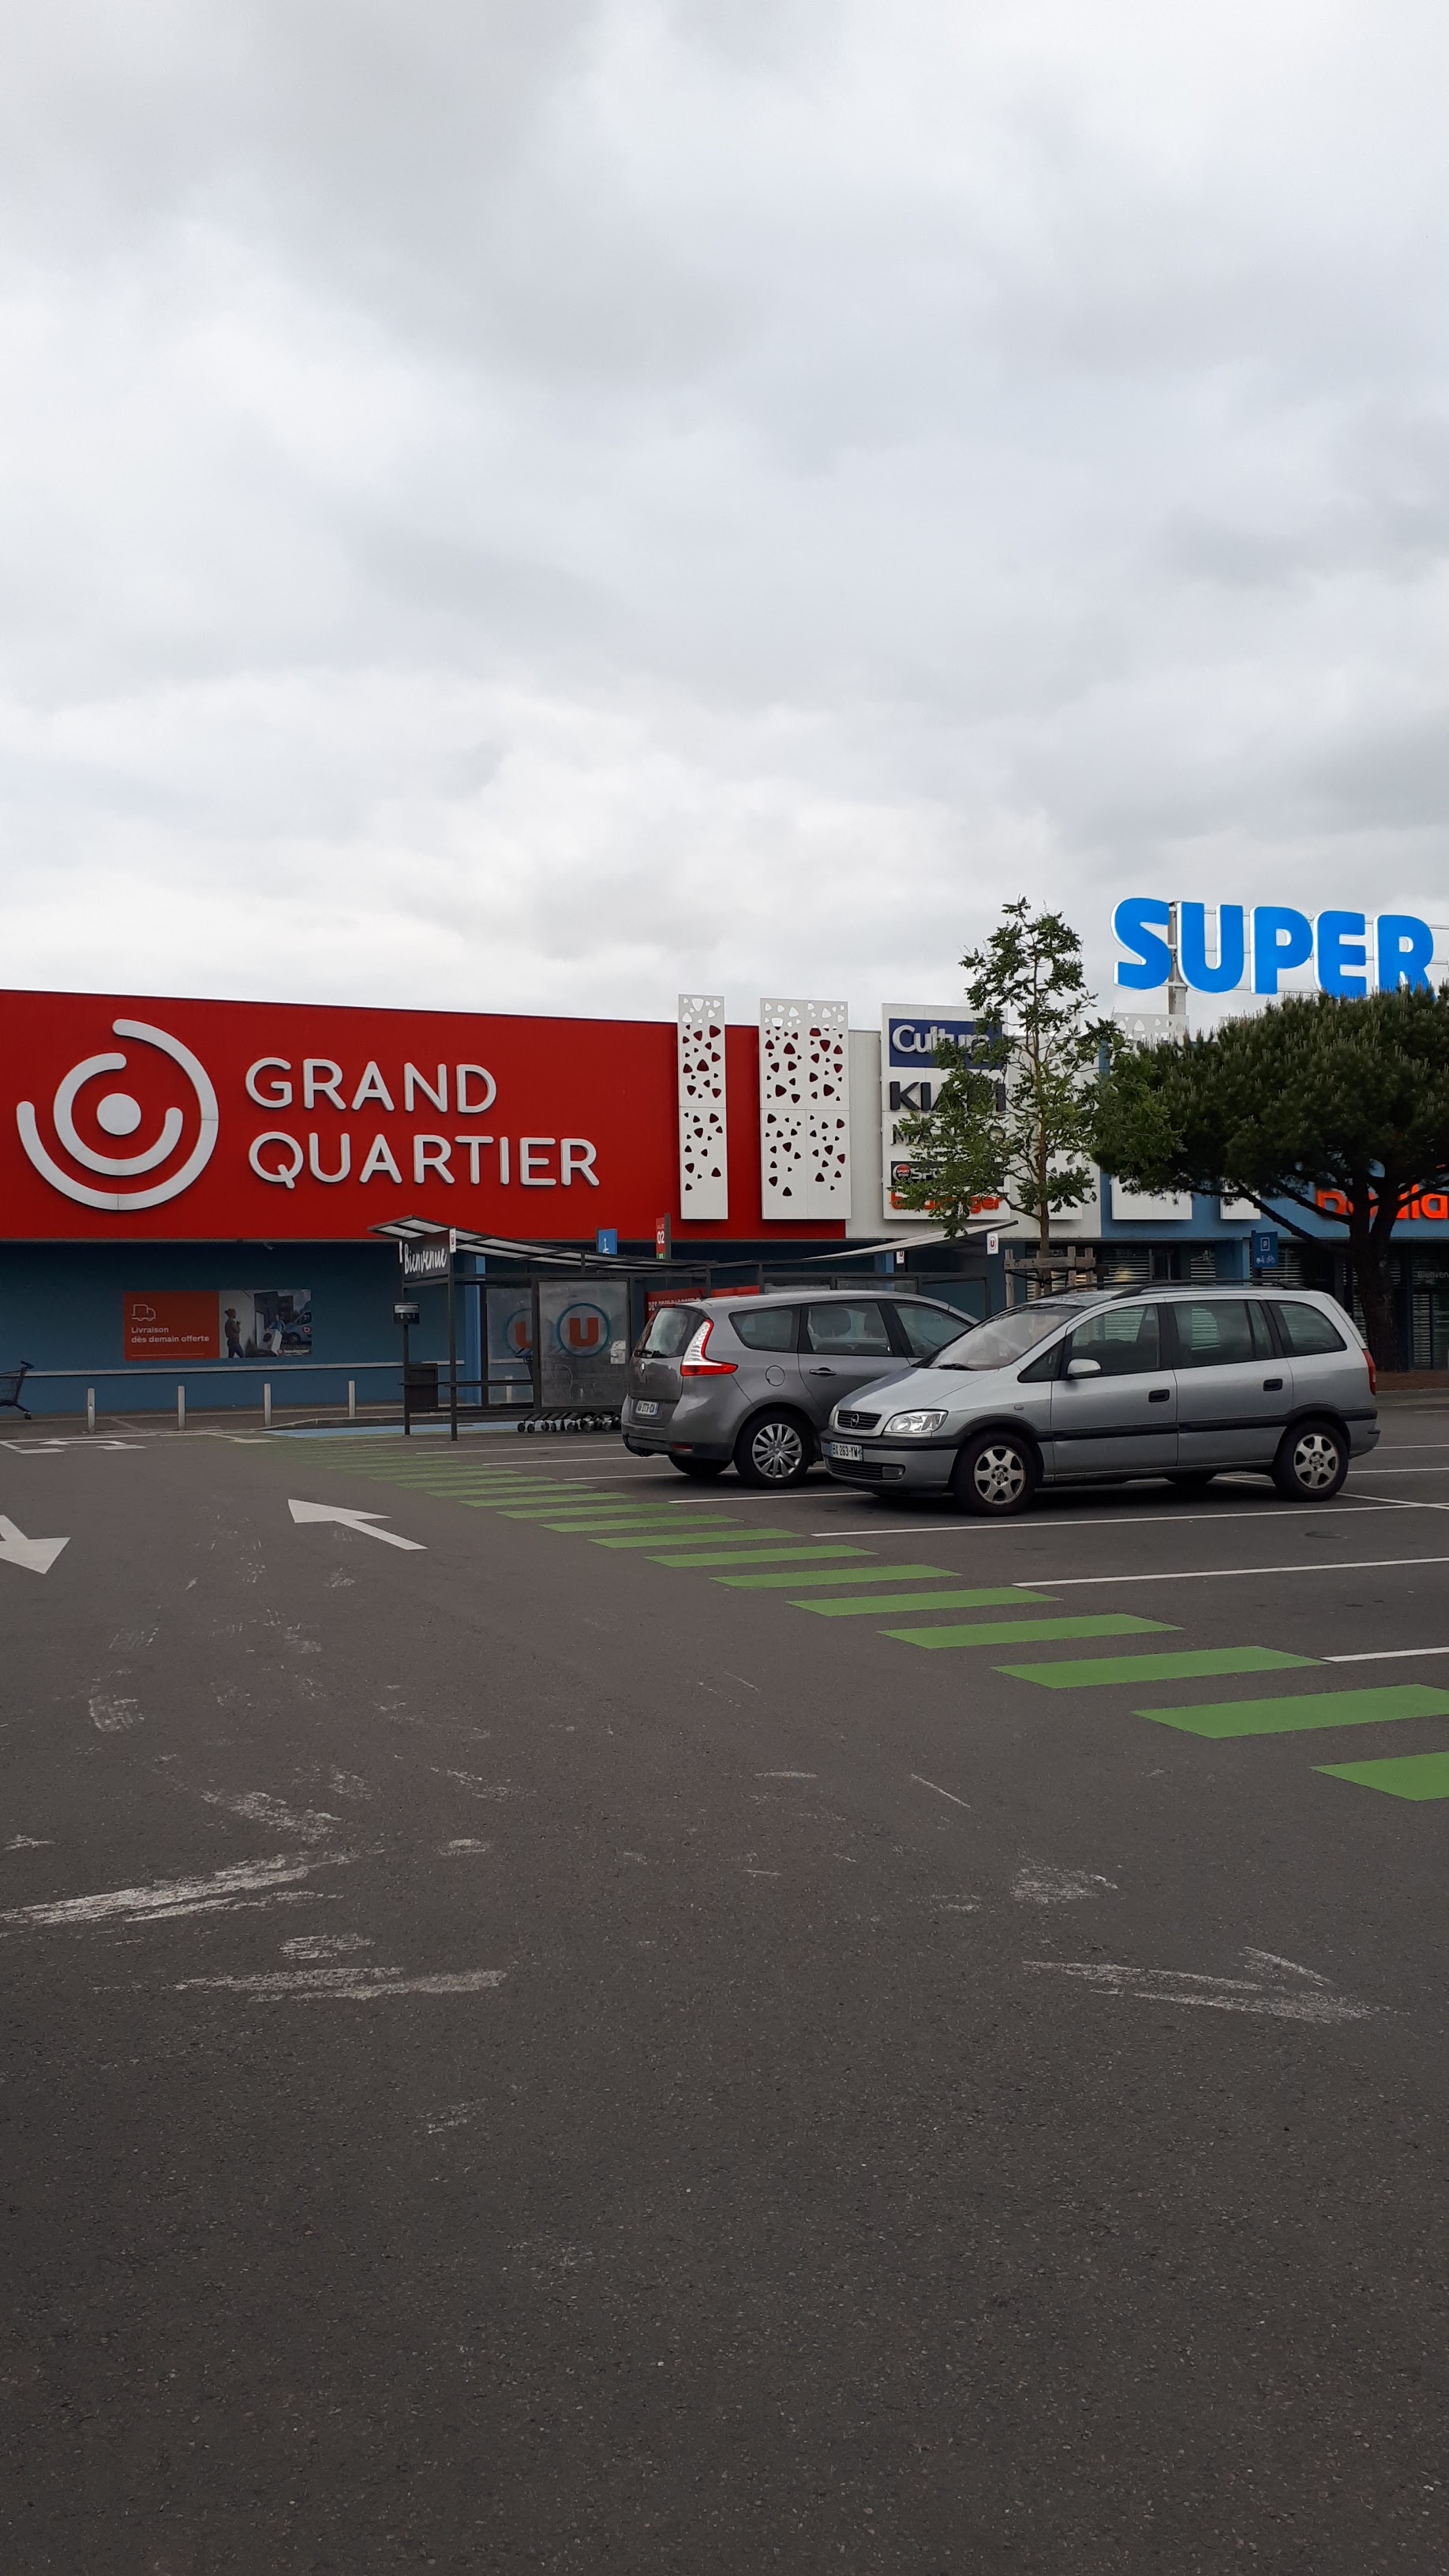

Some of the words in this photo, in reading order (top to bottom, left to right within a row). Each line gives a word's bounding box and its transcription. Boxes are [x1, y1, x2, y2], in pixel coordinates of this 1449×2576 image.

[1110, 897, 1436, 1001] SUPER
[245, 1057, 497, 1114] GRAND
[889, 1081, 1006, 1112] KII
[249, 1131, 600, 1189] QUARTIER
[657, 1230, 665, 1244] 02
[403, 1243, 447, 1275] Bienvenue
[569, 1317, 599, 1347] U
